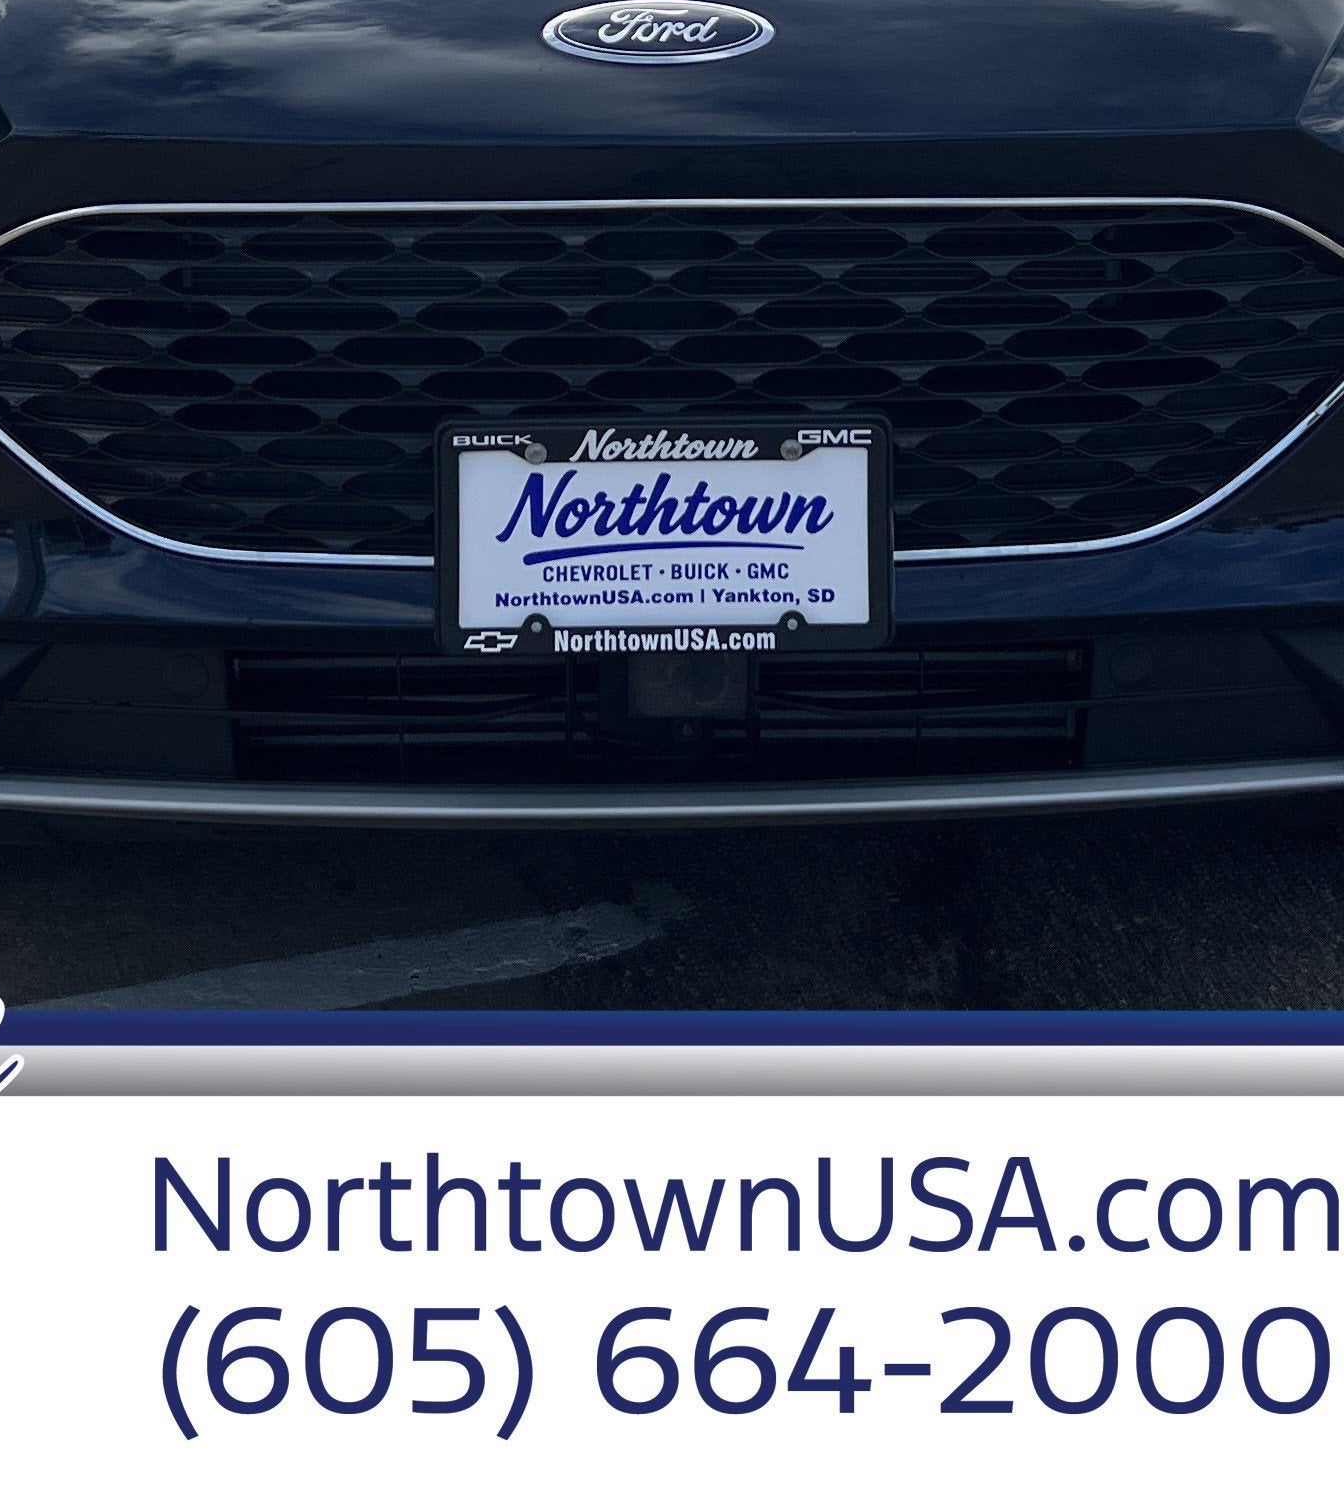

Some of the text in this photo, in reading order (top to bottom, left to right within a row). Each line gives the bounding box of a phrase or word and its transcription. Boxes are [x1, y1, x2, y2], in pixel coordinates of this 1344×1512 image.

[598, 8, 720, 43] Ford
[453, 428, 873, 463] BUICK Northtown GMC
[496, 469, 834, 542] Northtown
[543, 562, 790, 583] CHEVROLET BUICK GMC
[495, 588, 835, 608] NorthtownUSA.com Yankton, SD
[554, 629, 776, 654] NorthtownUSA.com
